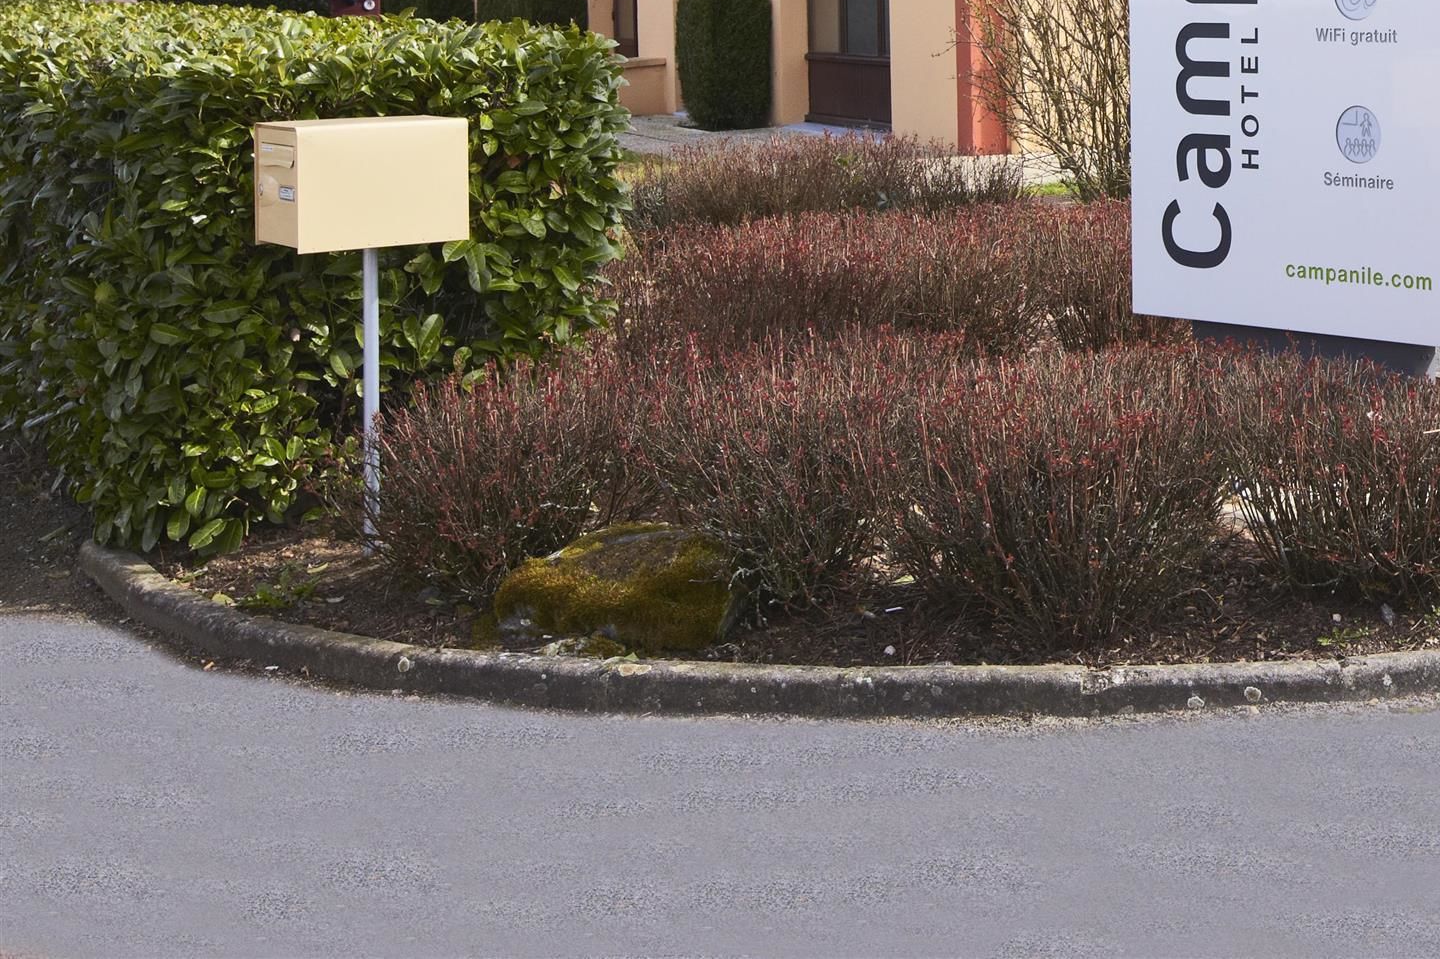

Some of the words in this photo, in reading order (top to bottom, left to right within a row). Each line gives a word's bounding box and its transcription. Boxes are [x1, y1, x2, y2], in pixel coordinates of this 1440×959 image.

[1315, 27, 1346, 43] WiFi
[1350, 28, 1398, 46] gratuit
[1240, 27, 1259, 170] HOTEL
[1323, 171, 1395, 190] Séminaire
[1285, 263, 1433, 291] campanile.com
